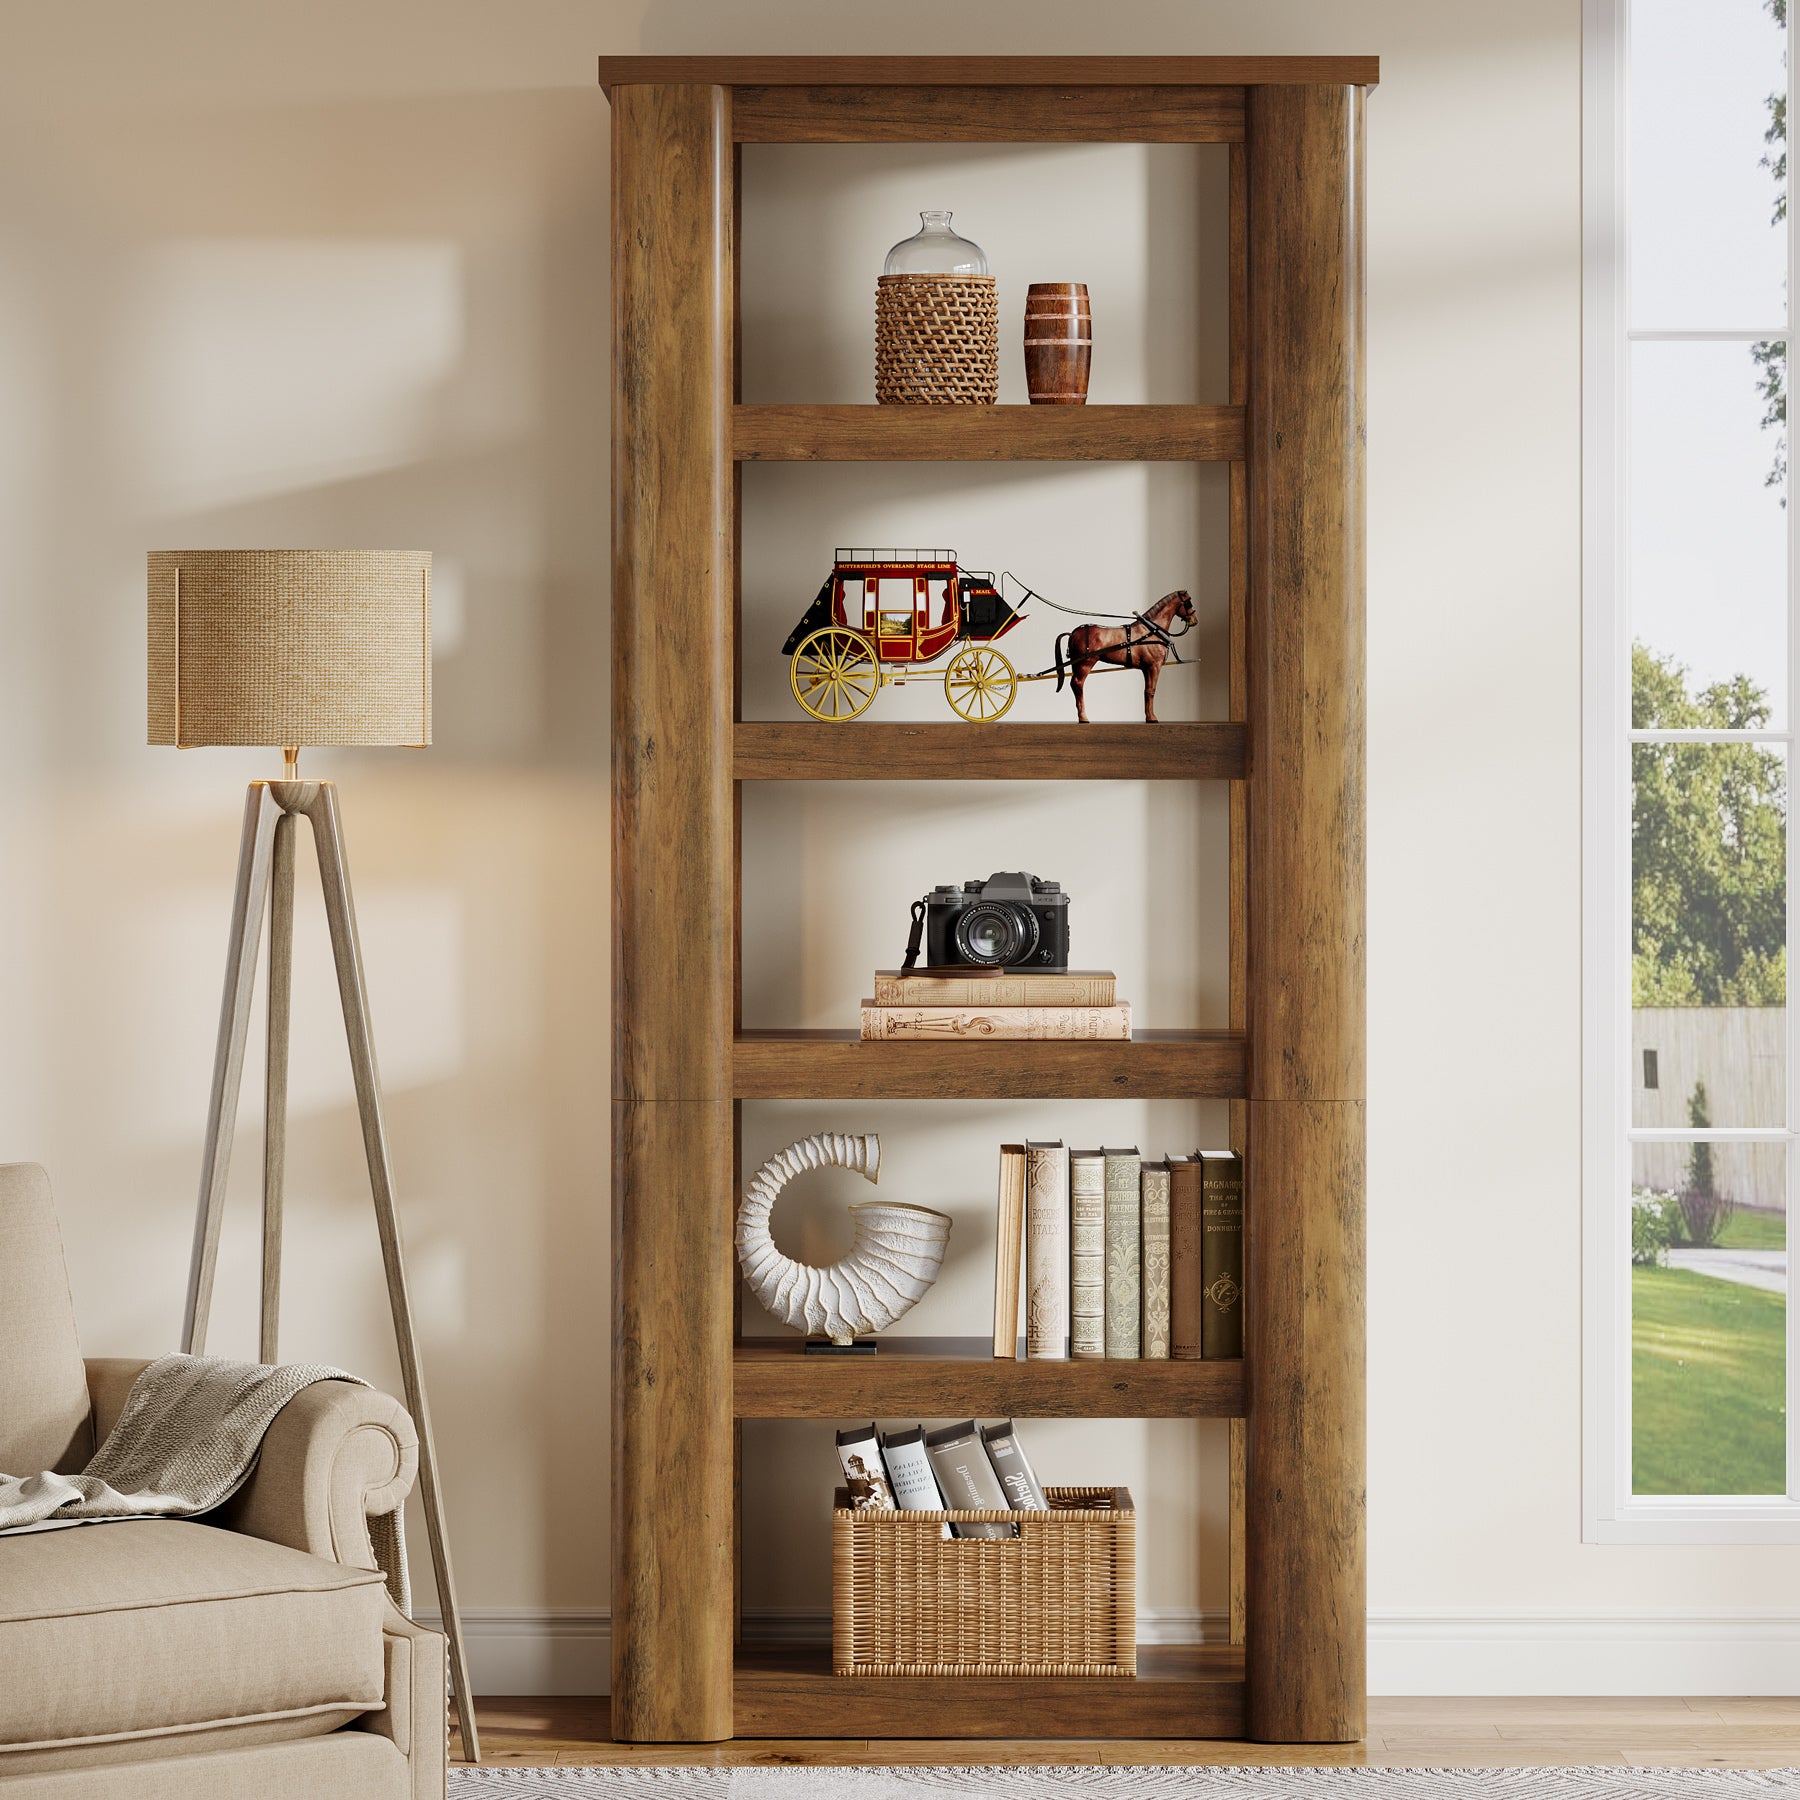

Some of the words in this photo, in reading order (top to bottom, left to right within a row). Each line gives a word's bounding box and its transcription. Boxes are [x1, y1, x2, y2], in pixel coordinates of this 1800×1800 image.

[1088, 1009, 1102, 1039] Charm
[1108, 1204, 1139, 1213] FRIENDS
[1032, 1224, 1058, 1235] ITALY
